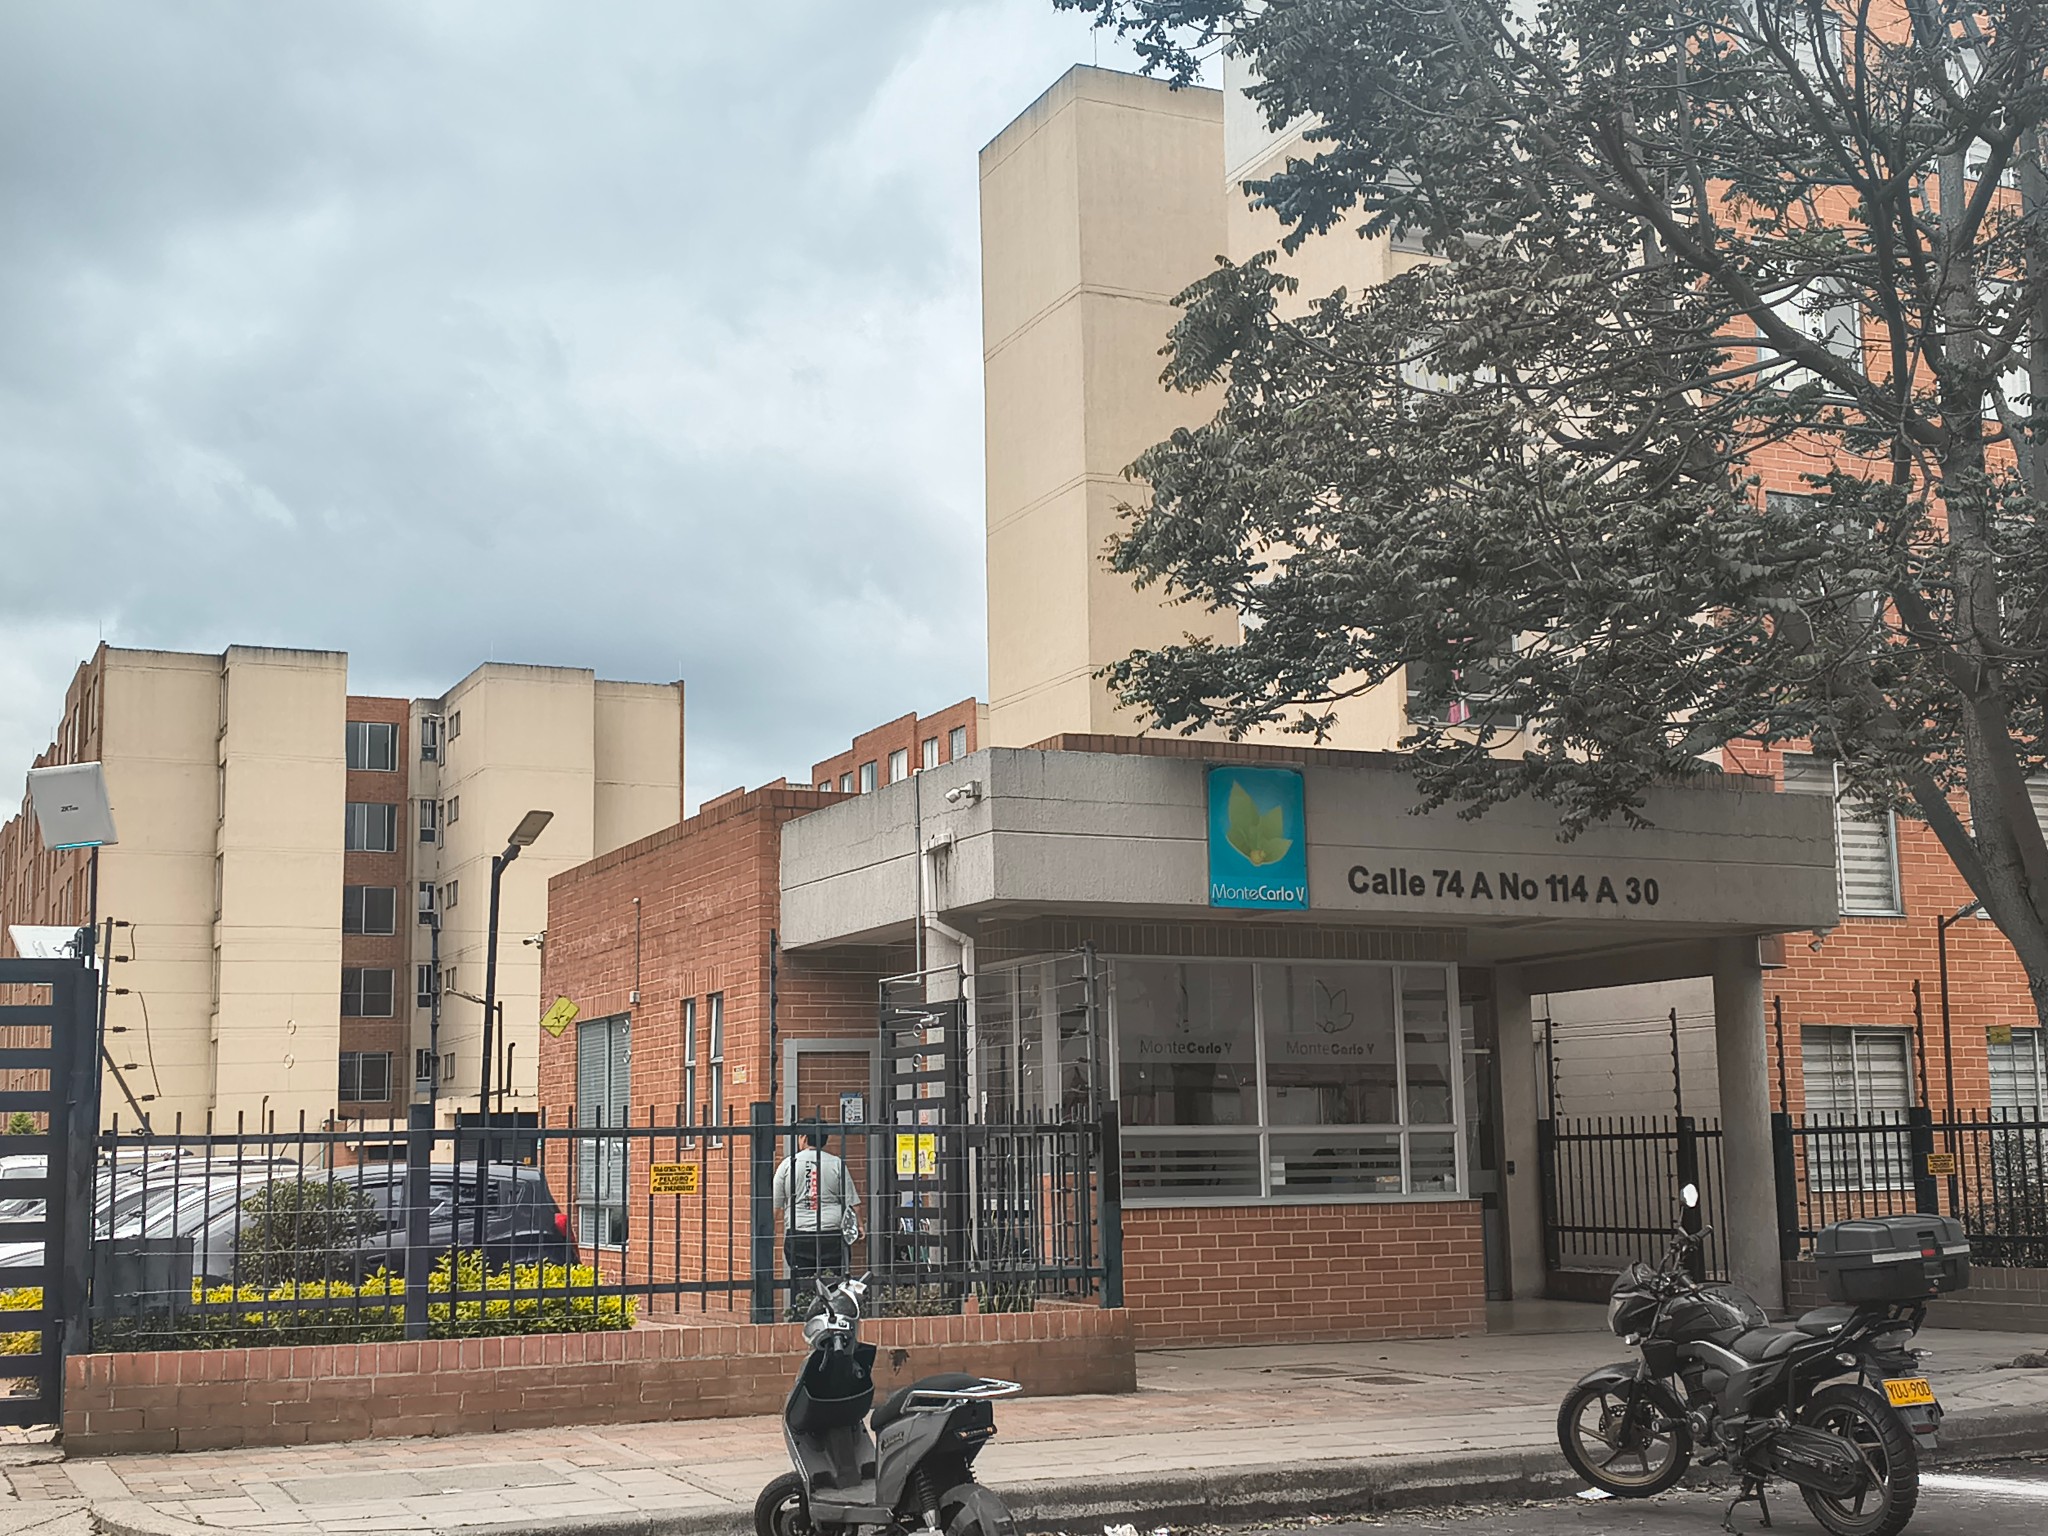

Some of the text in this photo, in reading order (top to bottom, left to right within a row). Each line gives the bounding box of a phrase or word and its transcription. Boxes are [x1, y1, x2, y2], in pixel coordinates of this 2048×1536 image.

[1212, 883, 1305, 902] MonteCarlo V
[1348, 865, 1660, 906] Calle 74 A No 114 A 30
[1140, 1039, 1222, 1055] MonteCarlo
[1286, 1041, 1364, 1055] MonteCarlo
